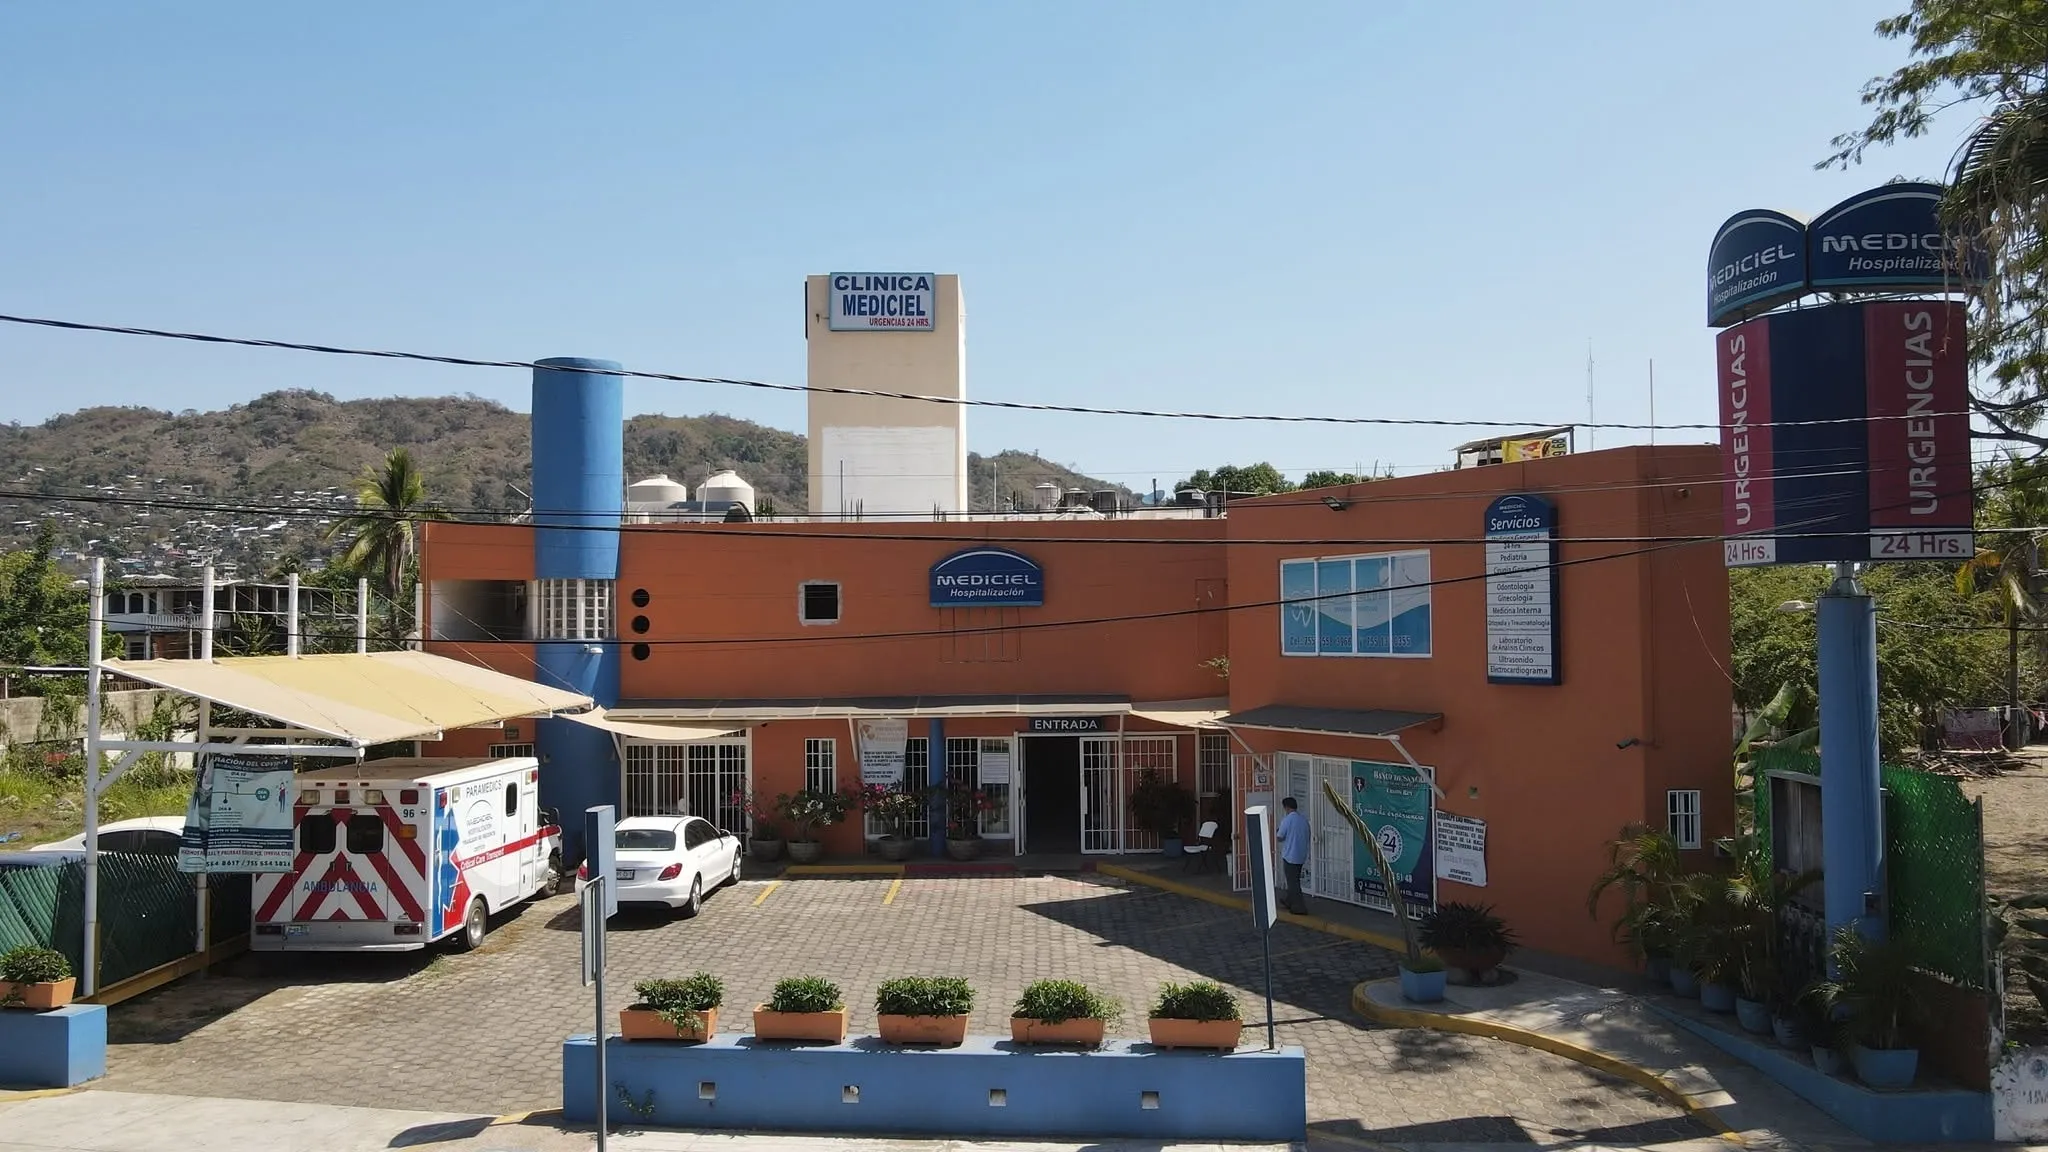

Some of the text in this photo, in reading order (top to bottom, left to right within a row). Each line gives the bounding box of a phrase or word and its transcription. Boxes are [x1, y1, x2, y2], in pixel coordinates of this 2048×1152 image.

[834, 275, 930, 291] CLINICA
[1713, 270, 1777, 307] Hospitalización
[843, 294, 926, 316] MEDICIEL
[869, 317, 906, 326] URGENCIAS
[907, 318, 915, 327] 24
[1904, 311, 1938, 515] URGENCIAS
[1731, 334, 1750, 525] URGENCIAS
[1490, 514, 1541, 530] Servicios
[1727, 541, 1770, 562] 24 Hrs.
[1881, 535, 1966, 554] 24 Hrs.
[937, 575, 1037, 586] MEDICIEL
[950, 588, 1024, 598] Hospitalización
[1517, 606, 1542, 614] Interna
[1498, 655, 1534, 663] Ultrasonido
[1490, 665, 1548, 675] Electrocardiograma
[1034, 719, 1098, 730] ENTRADA
[466, 779, 502, 798] PARAMEDICS
[403, 809, 414, 818] 96
[1383, 833, 1397, 853] 24
[460, 858, 475, 871] Critical
[475, 854, 486, 867] Care
[303, 881, 378, 892] AMBULANCIA
